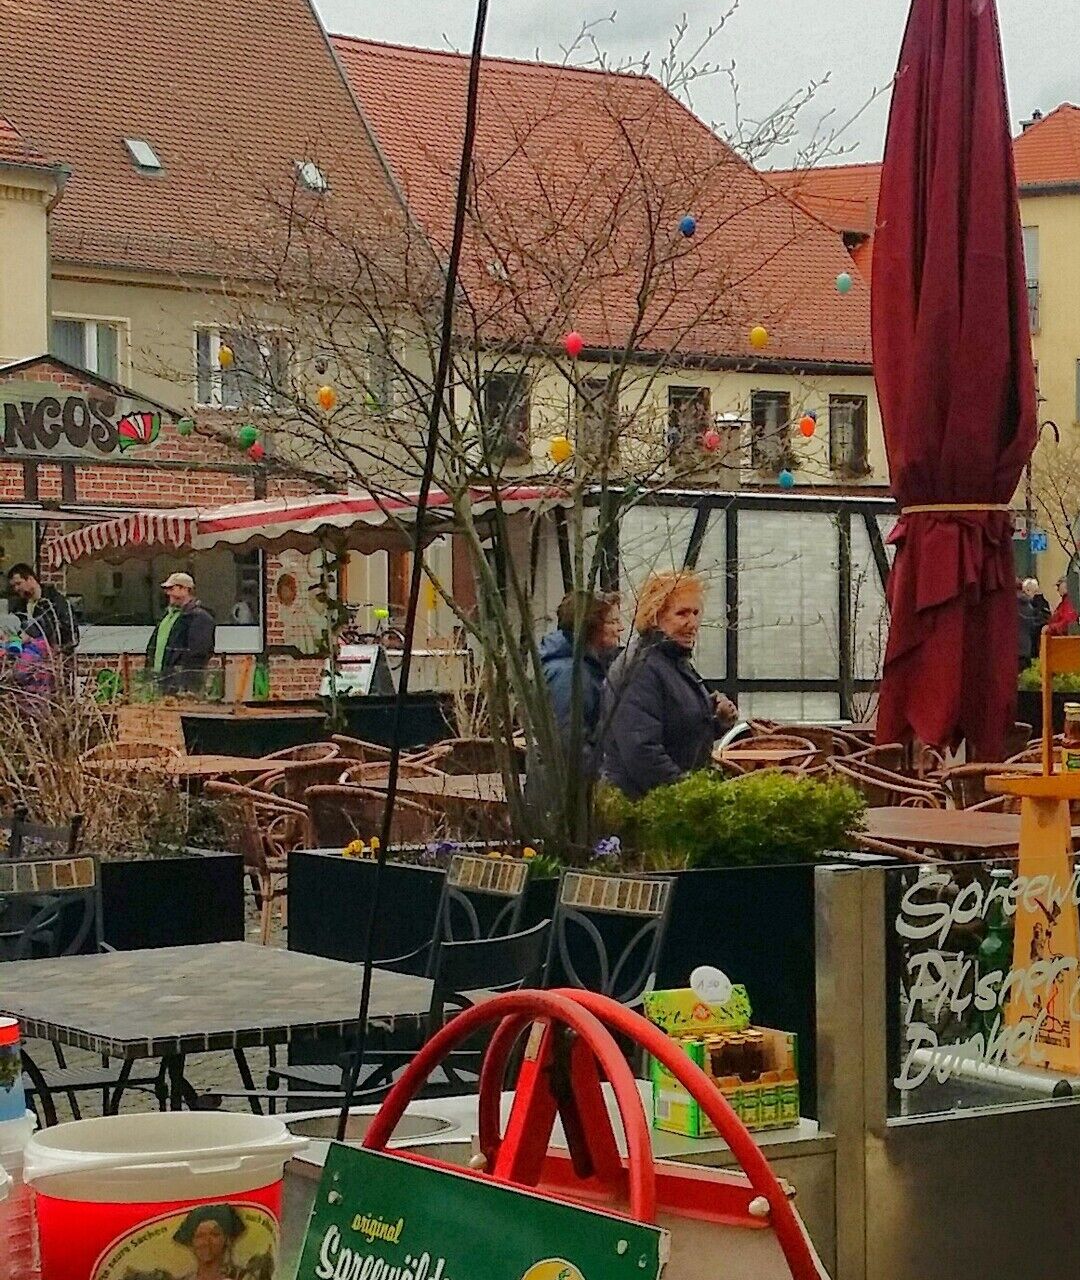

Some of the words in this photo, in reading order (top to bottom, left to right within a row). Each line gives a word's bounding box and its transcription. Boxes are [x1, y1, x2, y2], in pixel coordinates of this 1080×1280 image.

[0, 397, 118, 453] NGOS
[904, 949, 1079, 1023] Pilsner
[351, 1213, 404, 1244] original
